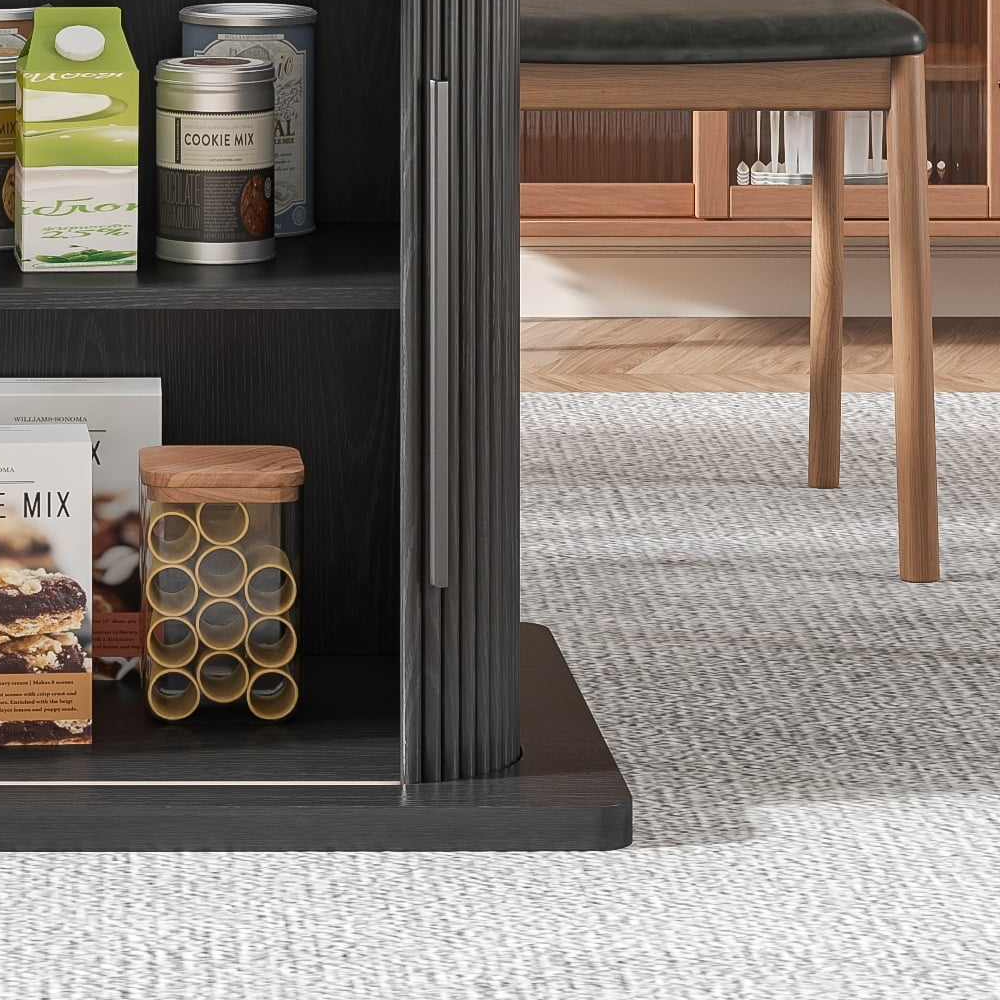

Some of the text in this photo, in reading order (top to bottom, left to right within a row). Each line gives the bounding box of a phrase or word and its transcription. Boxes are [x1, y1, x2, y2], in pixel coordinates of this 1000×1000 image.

[184, 132, 255, 147] COOKIE MIX
[23, 491, 71, 518] MIX
